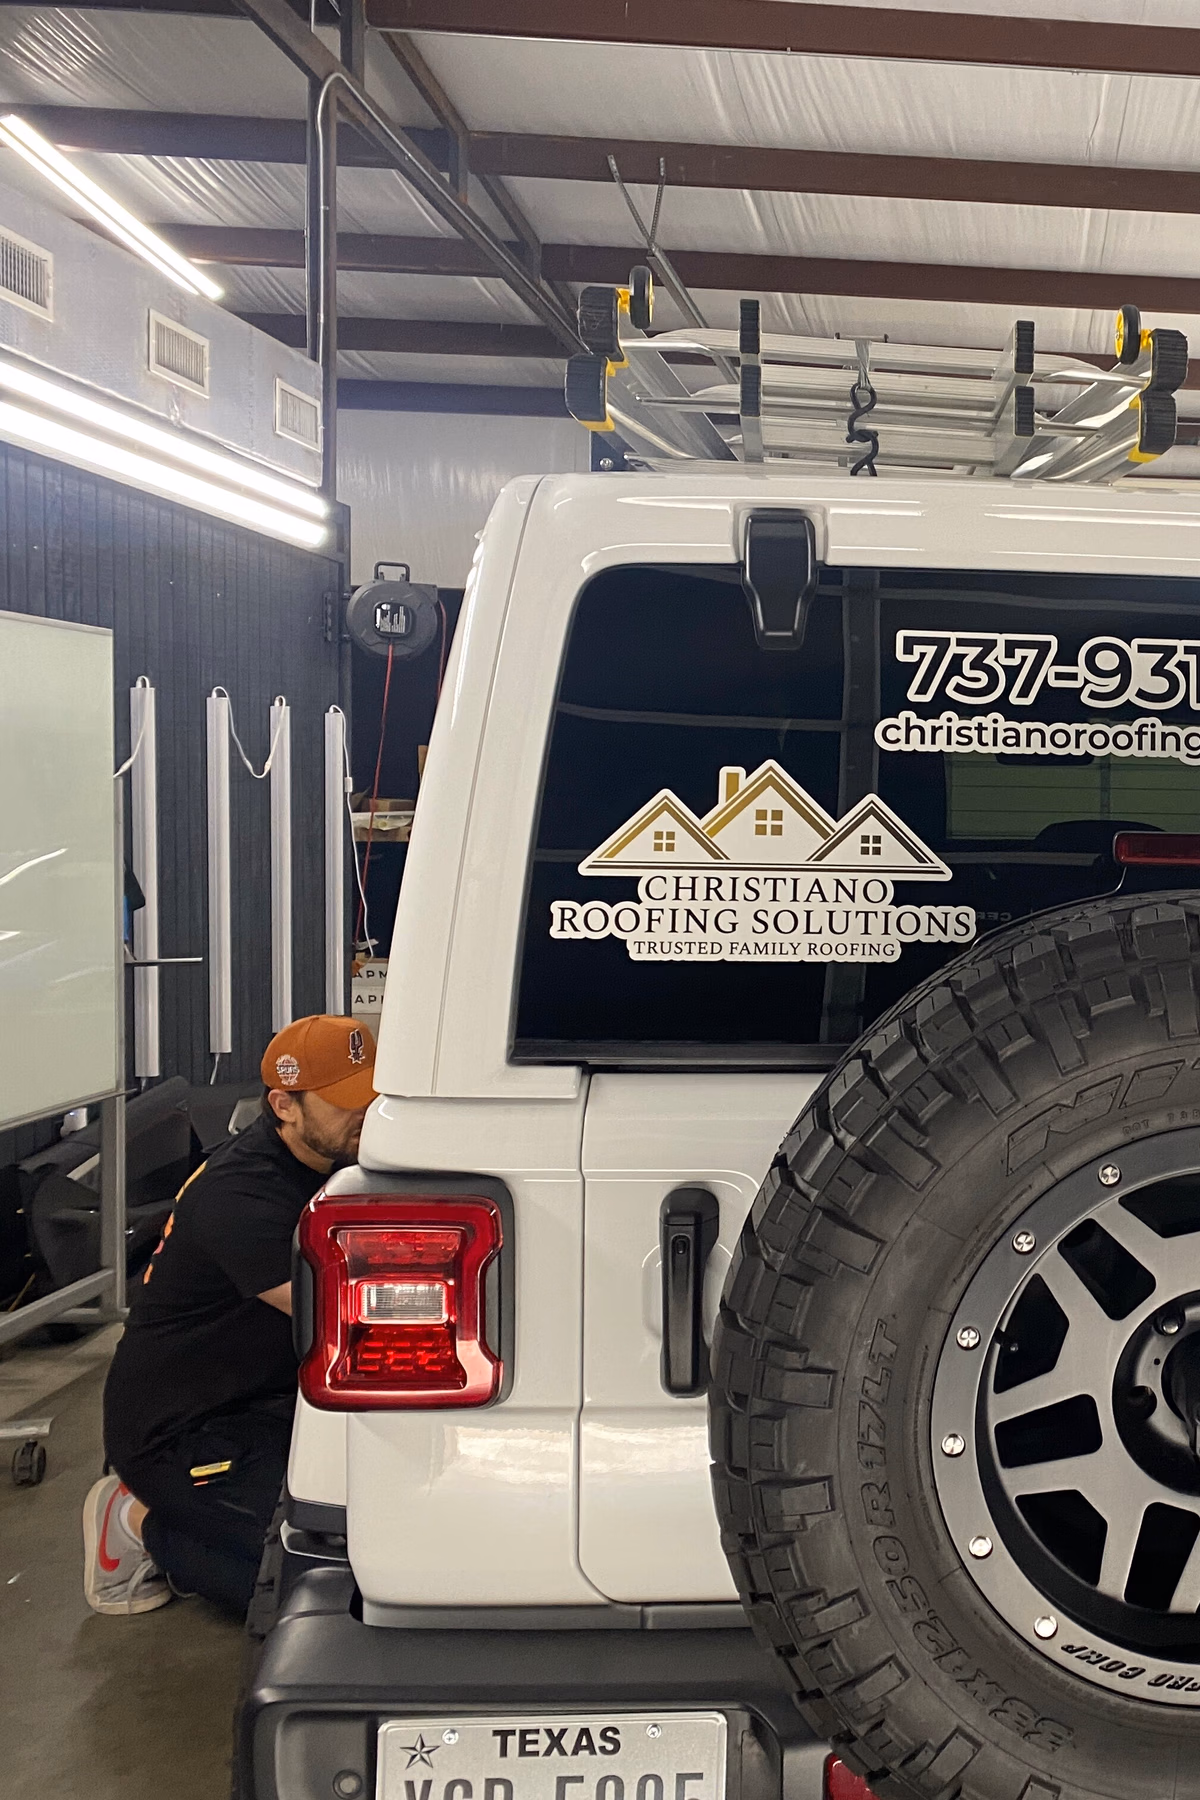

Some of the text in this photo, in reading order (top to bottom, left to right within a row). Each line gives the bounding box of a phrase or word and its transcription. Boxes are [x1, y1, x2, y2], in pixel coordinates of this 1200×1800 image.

[644, 875, 889, 904] CHRISTIANO
[556, 907, 971, 937] ROOFING SOLUTIONS
[633, 940, 896, 957] TRUSTED FAMILY ROOFING
[1061, 1644, 1146, 1679] COMP
[492, 1727, 621, 1758] TEXAS
